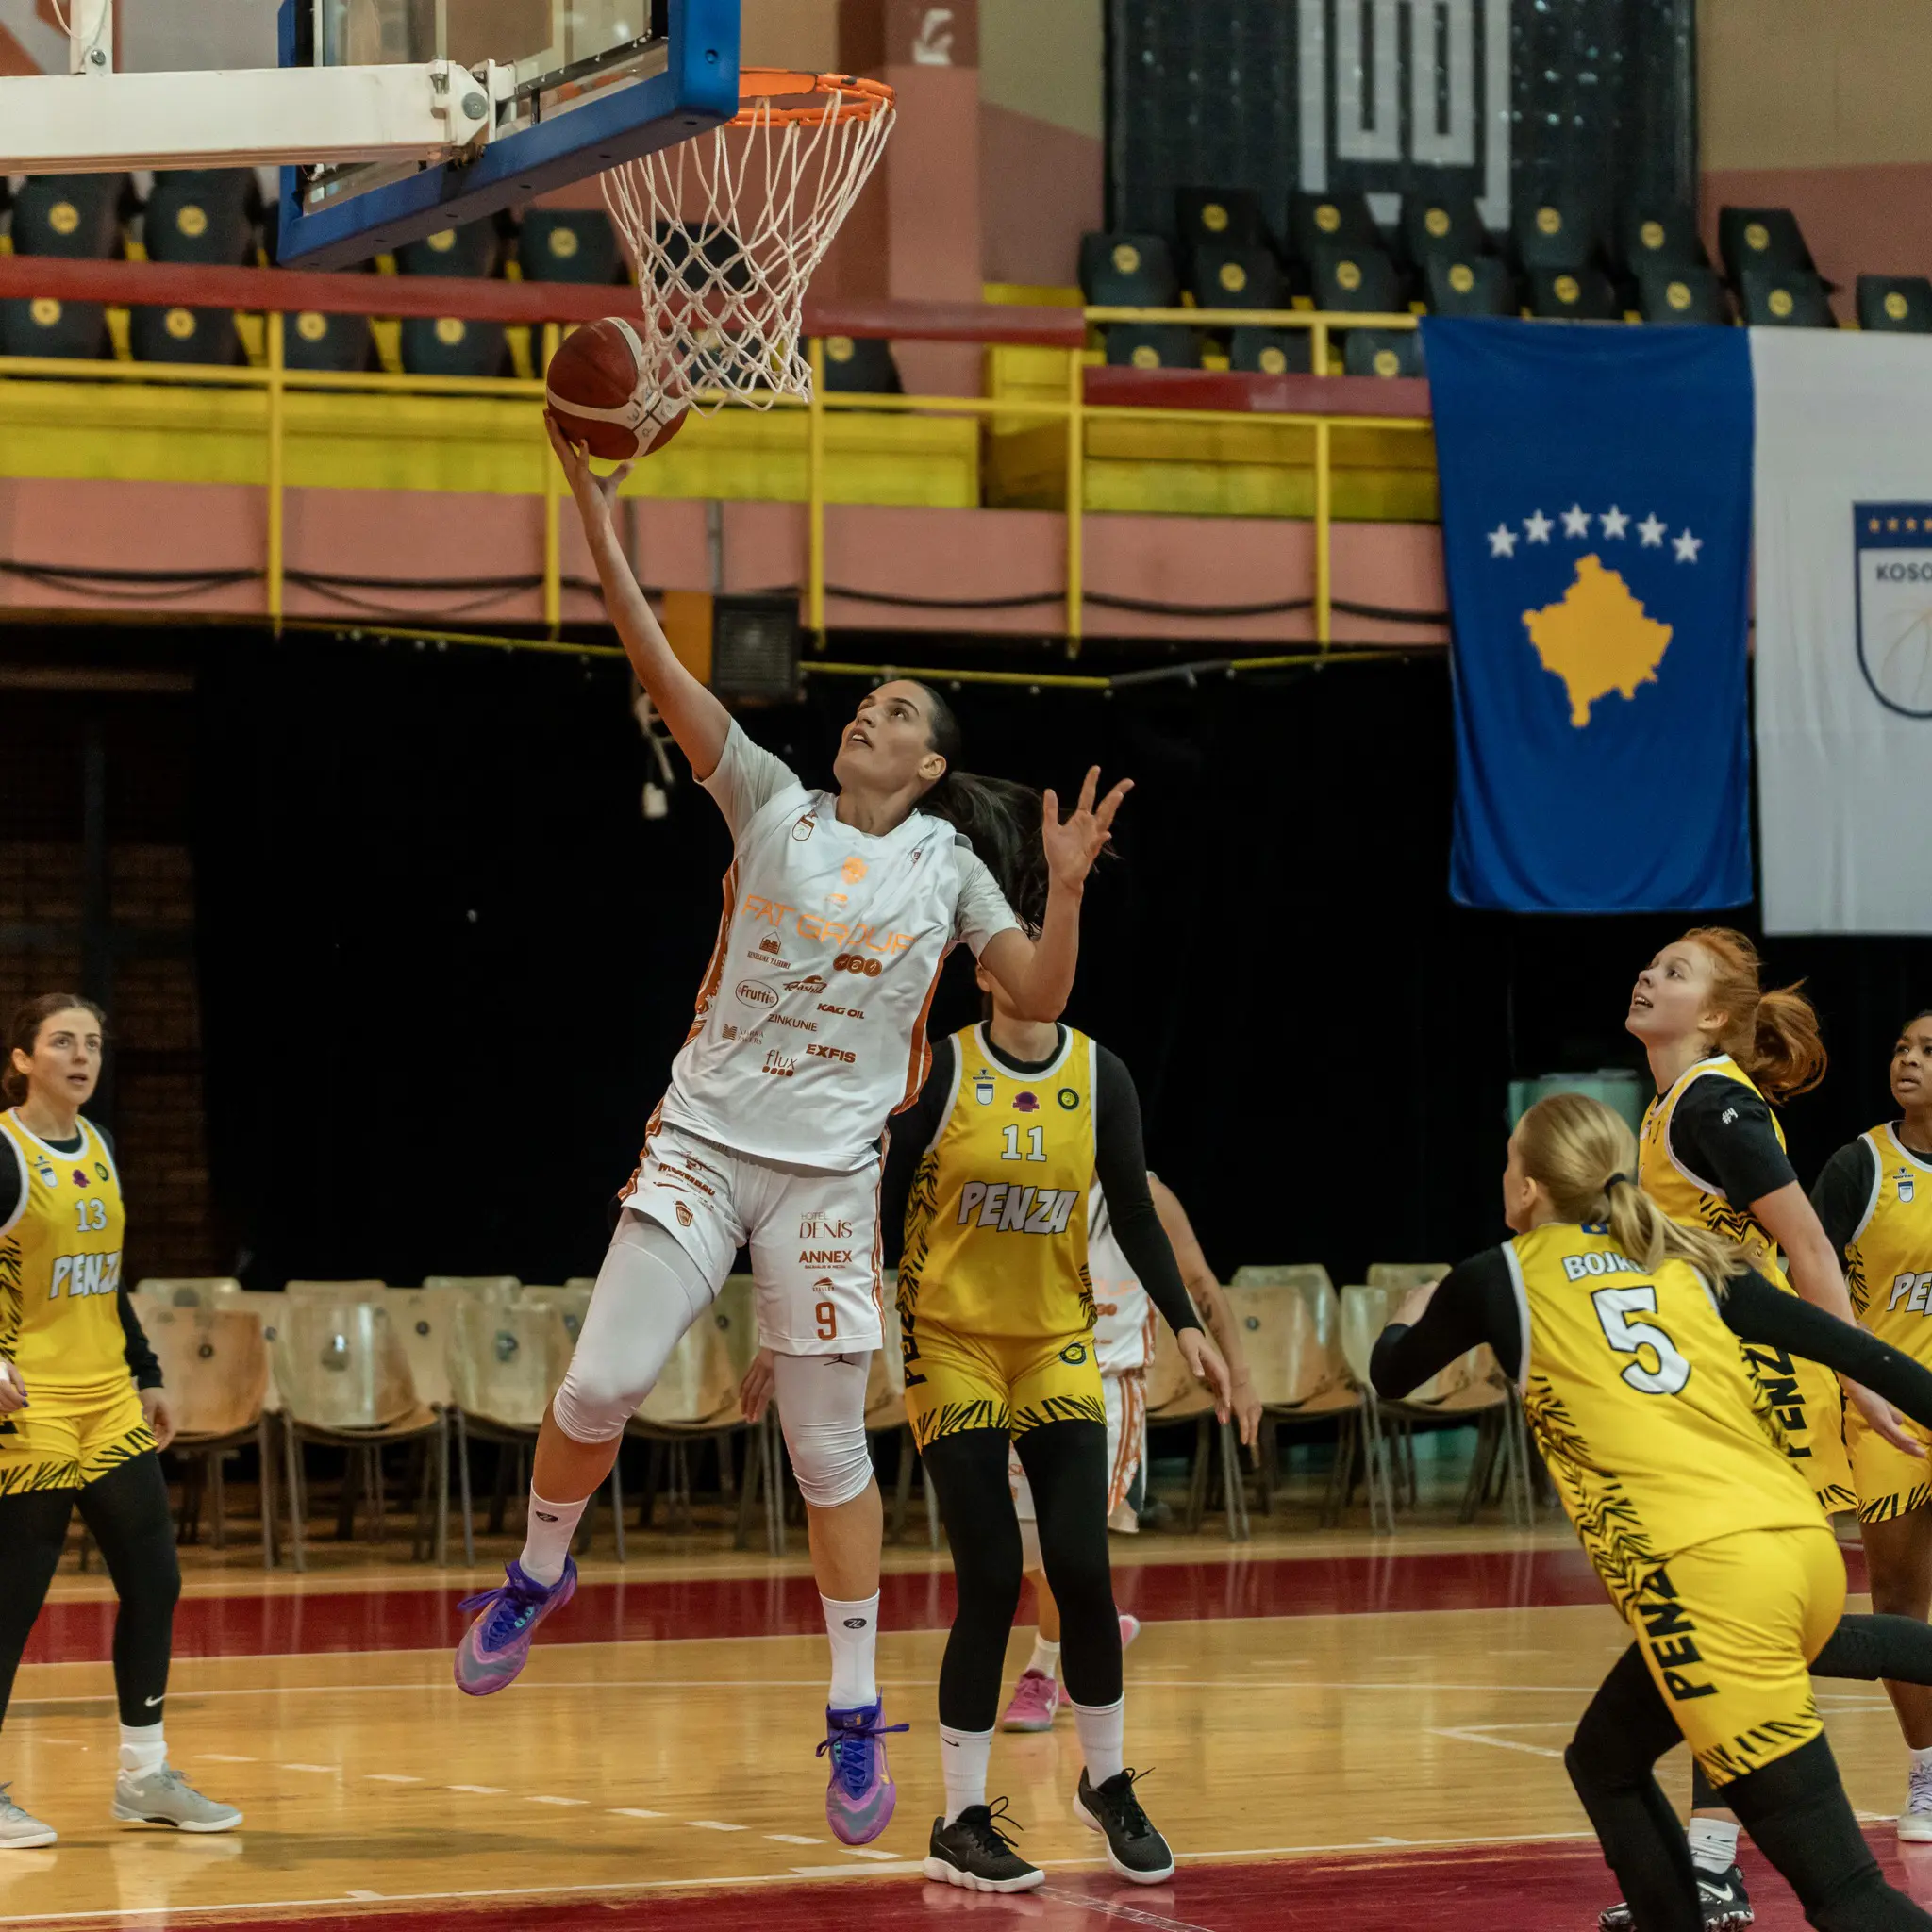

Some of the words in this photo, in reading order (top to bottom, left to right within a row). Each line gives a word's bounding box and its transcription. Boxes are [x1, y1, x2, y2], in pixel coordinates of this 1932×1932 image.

[741, 894, 795, 928] FAT
[816, 1003, 846, 1015] KAG
[846, 1009, 865, 1020] OIL
[766, 1048, 798, 1071] flux
[806, 1043, 857, 1064] EXFIS
[1000, 1124, 1048, 1163] 11
[75, 1197, 108, 1233] 13
[957, 1180, 1080, 1236] PENZA
[798, 1250, 853, 1264] ANNEX
[1887, 1271, 1932, 1317] PE
[814, 1301, 838, 1341] 9
[1590, 1285, 1691, 1396] 5
